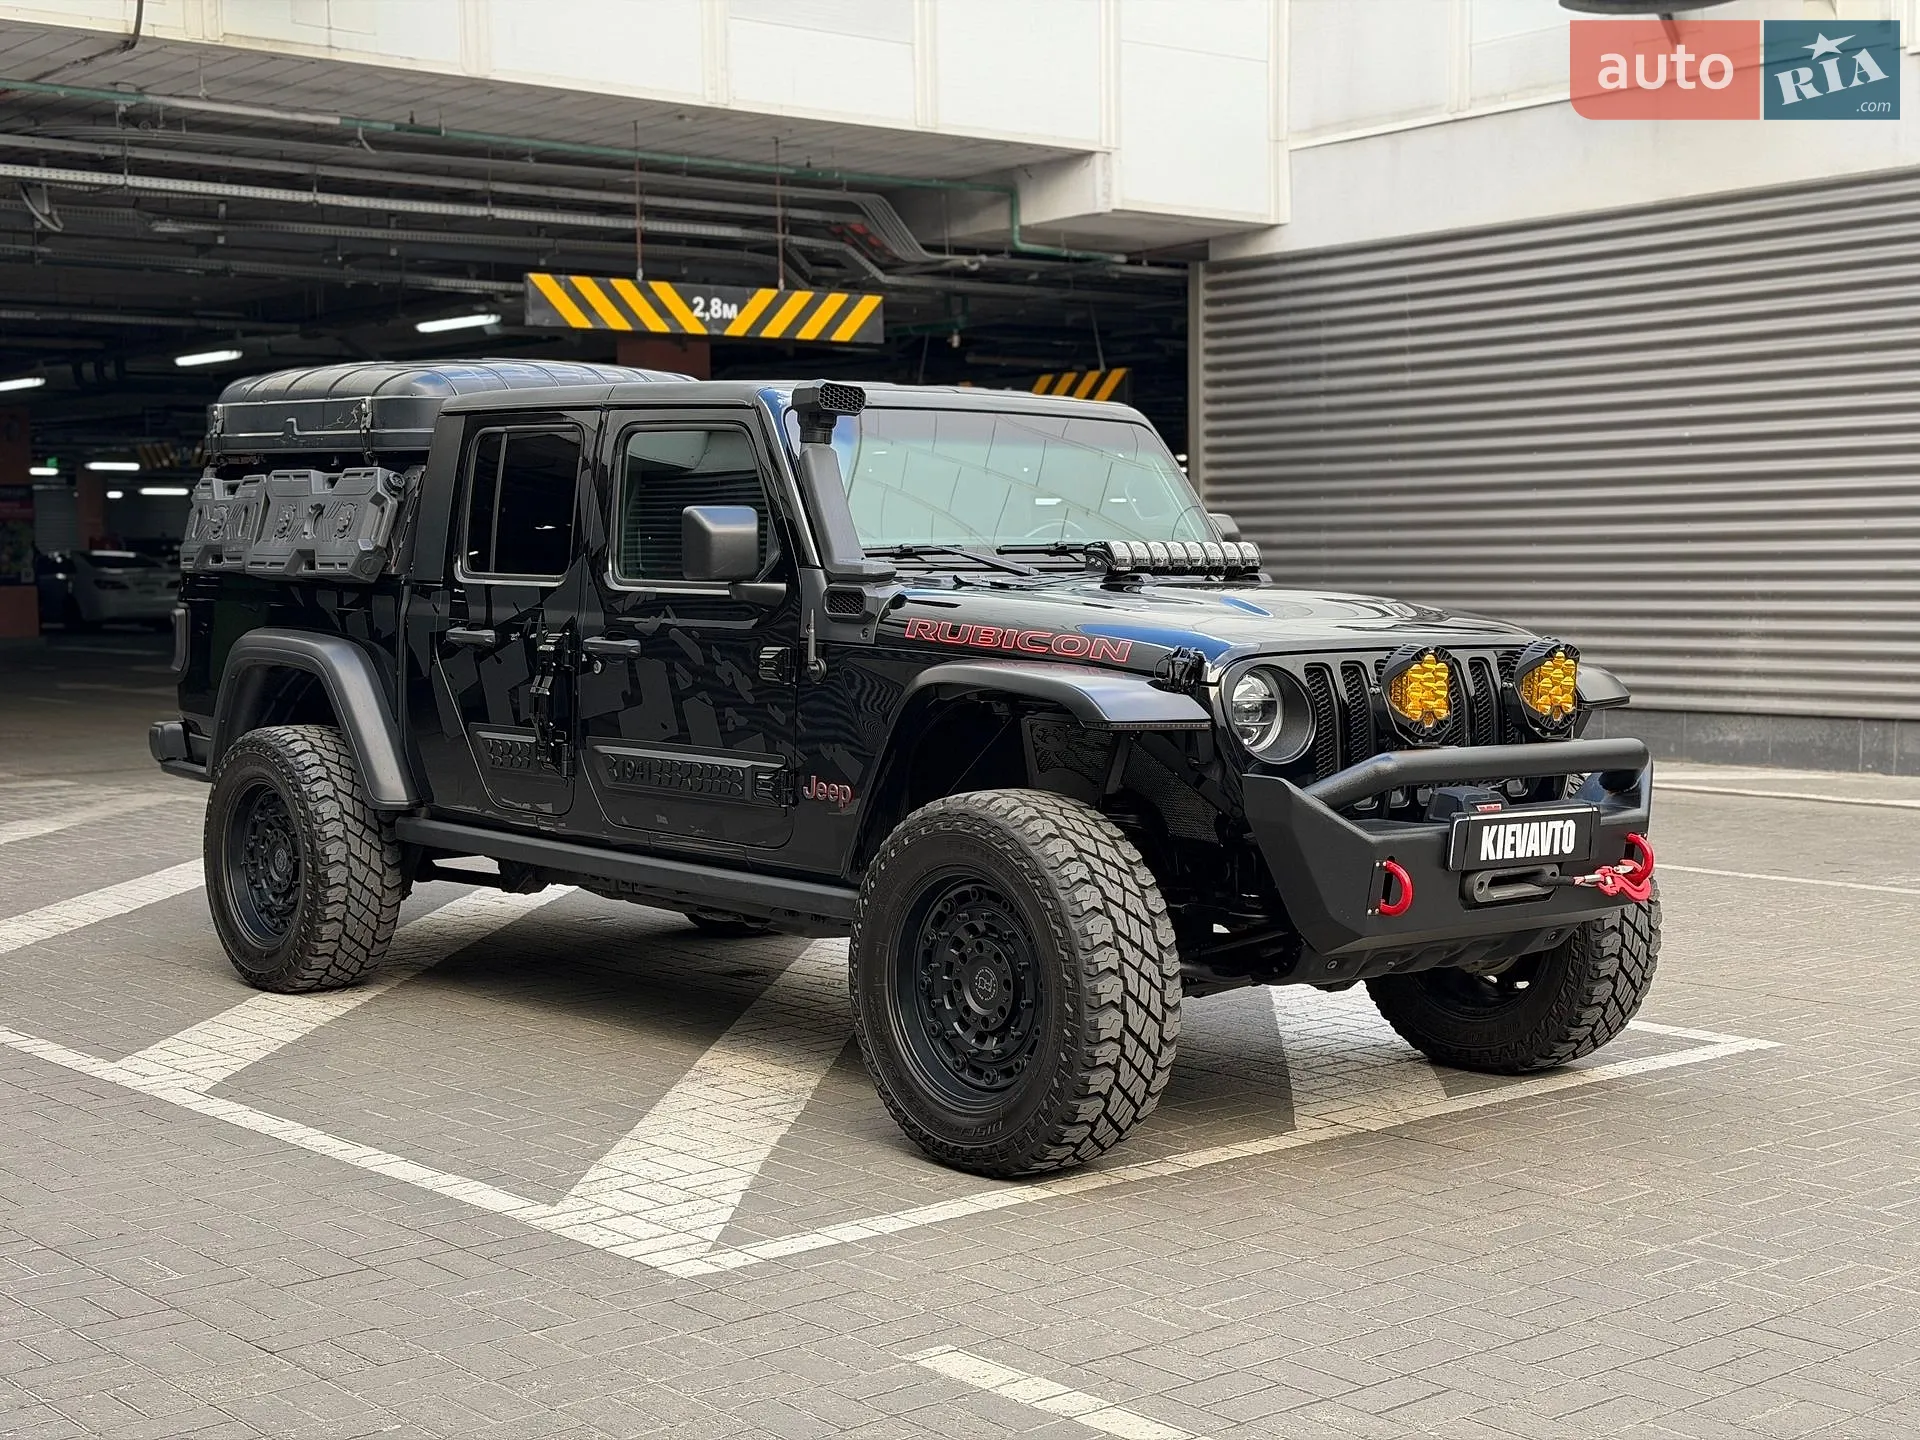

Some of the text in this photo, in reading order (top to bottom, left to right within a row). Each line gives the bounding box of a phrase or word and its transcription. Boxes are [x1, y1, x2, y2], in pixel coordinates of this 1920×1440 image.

[904, 617, 1133, 663] RUBICON
[802, 775, 855, 807] Jeep
[1480, 819, 1576, 861] KIEVAVTO
